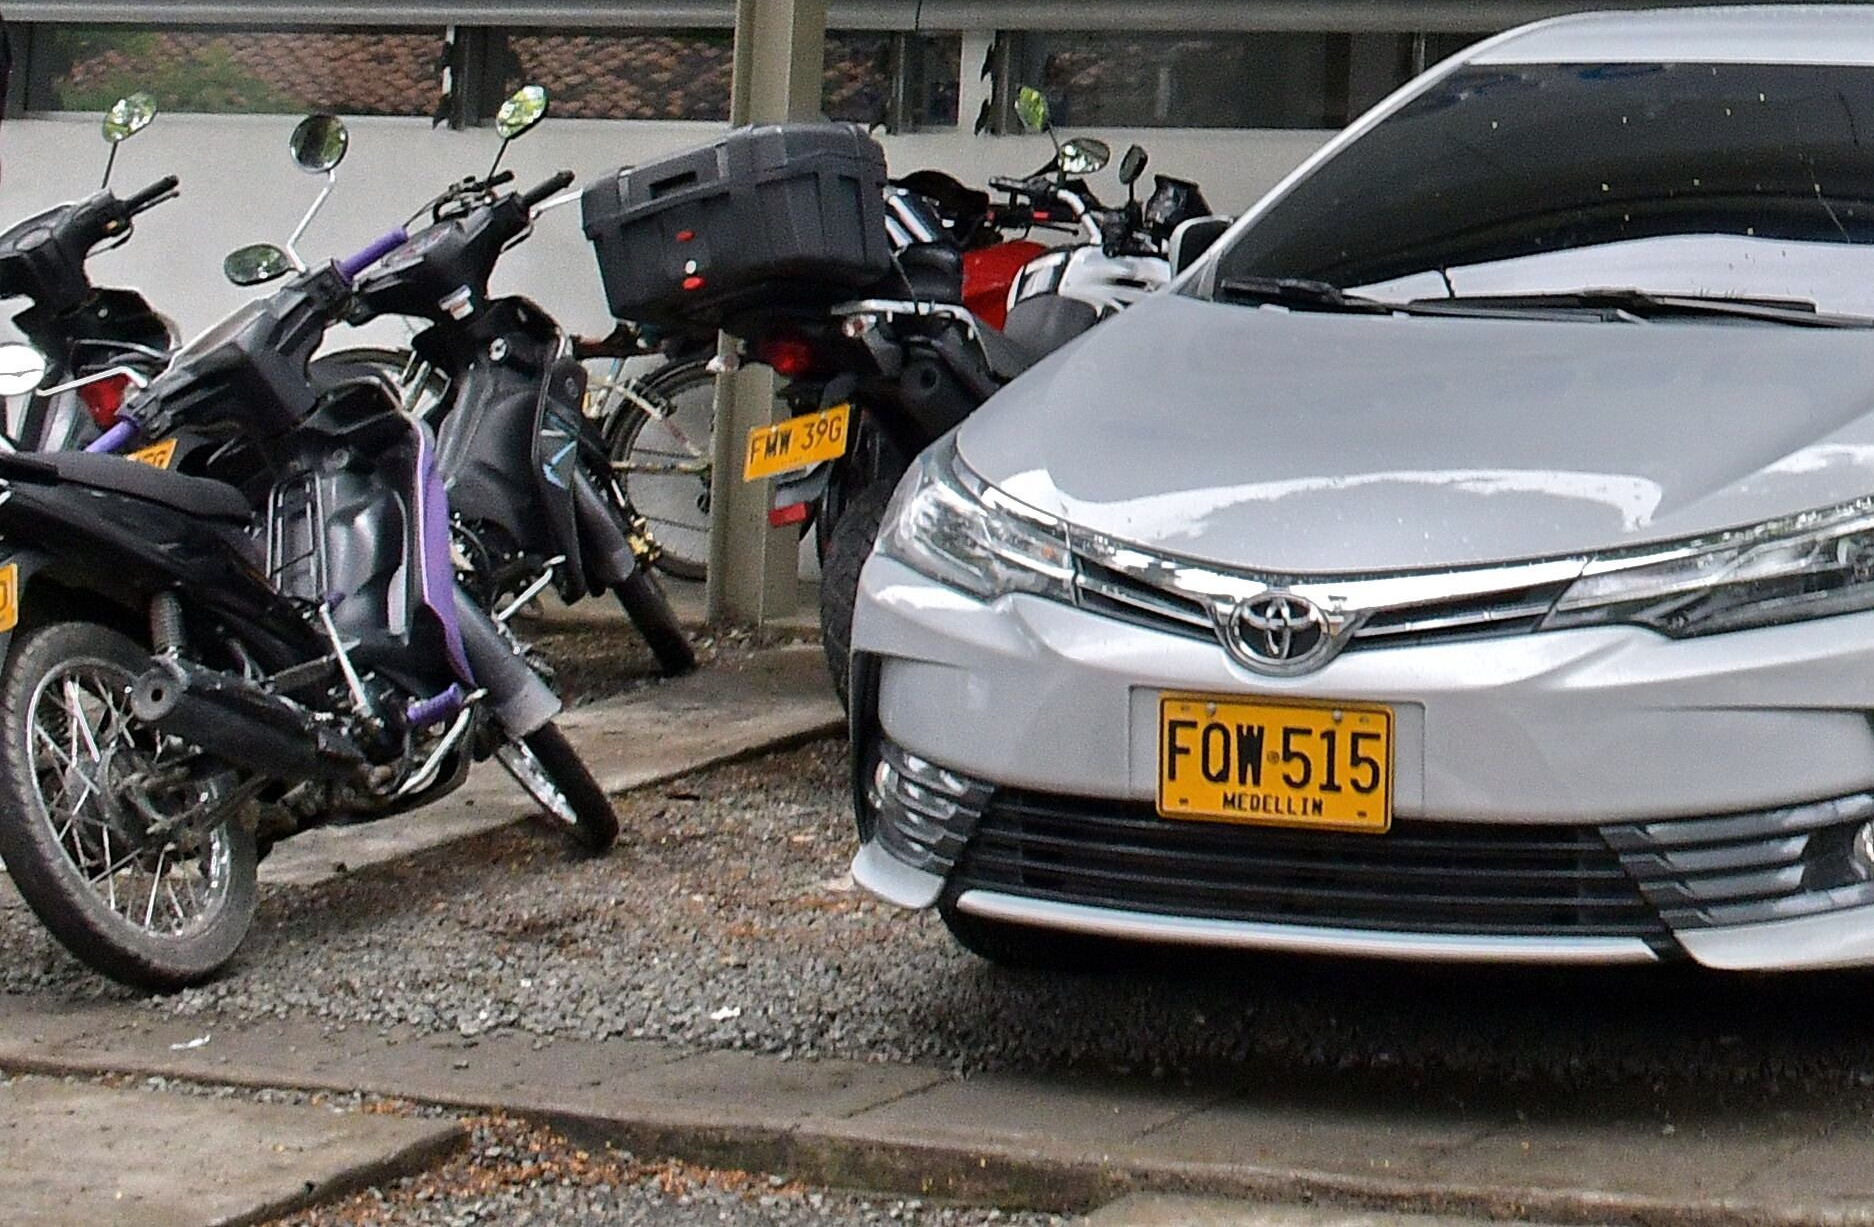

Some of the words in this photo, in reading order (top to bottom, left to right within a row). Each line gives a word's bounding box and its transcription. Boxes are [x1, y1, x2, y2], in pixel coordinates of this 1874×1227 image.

[800, 415, 843, 451] 39G
[1281, 726, 1382, 795] 515
[1222, 791, 1323, 817] MEDELLIN
